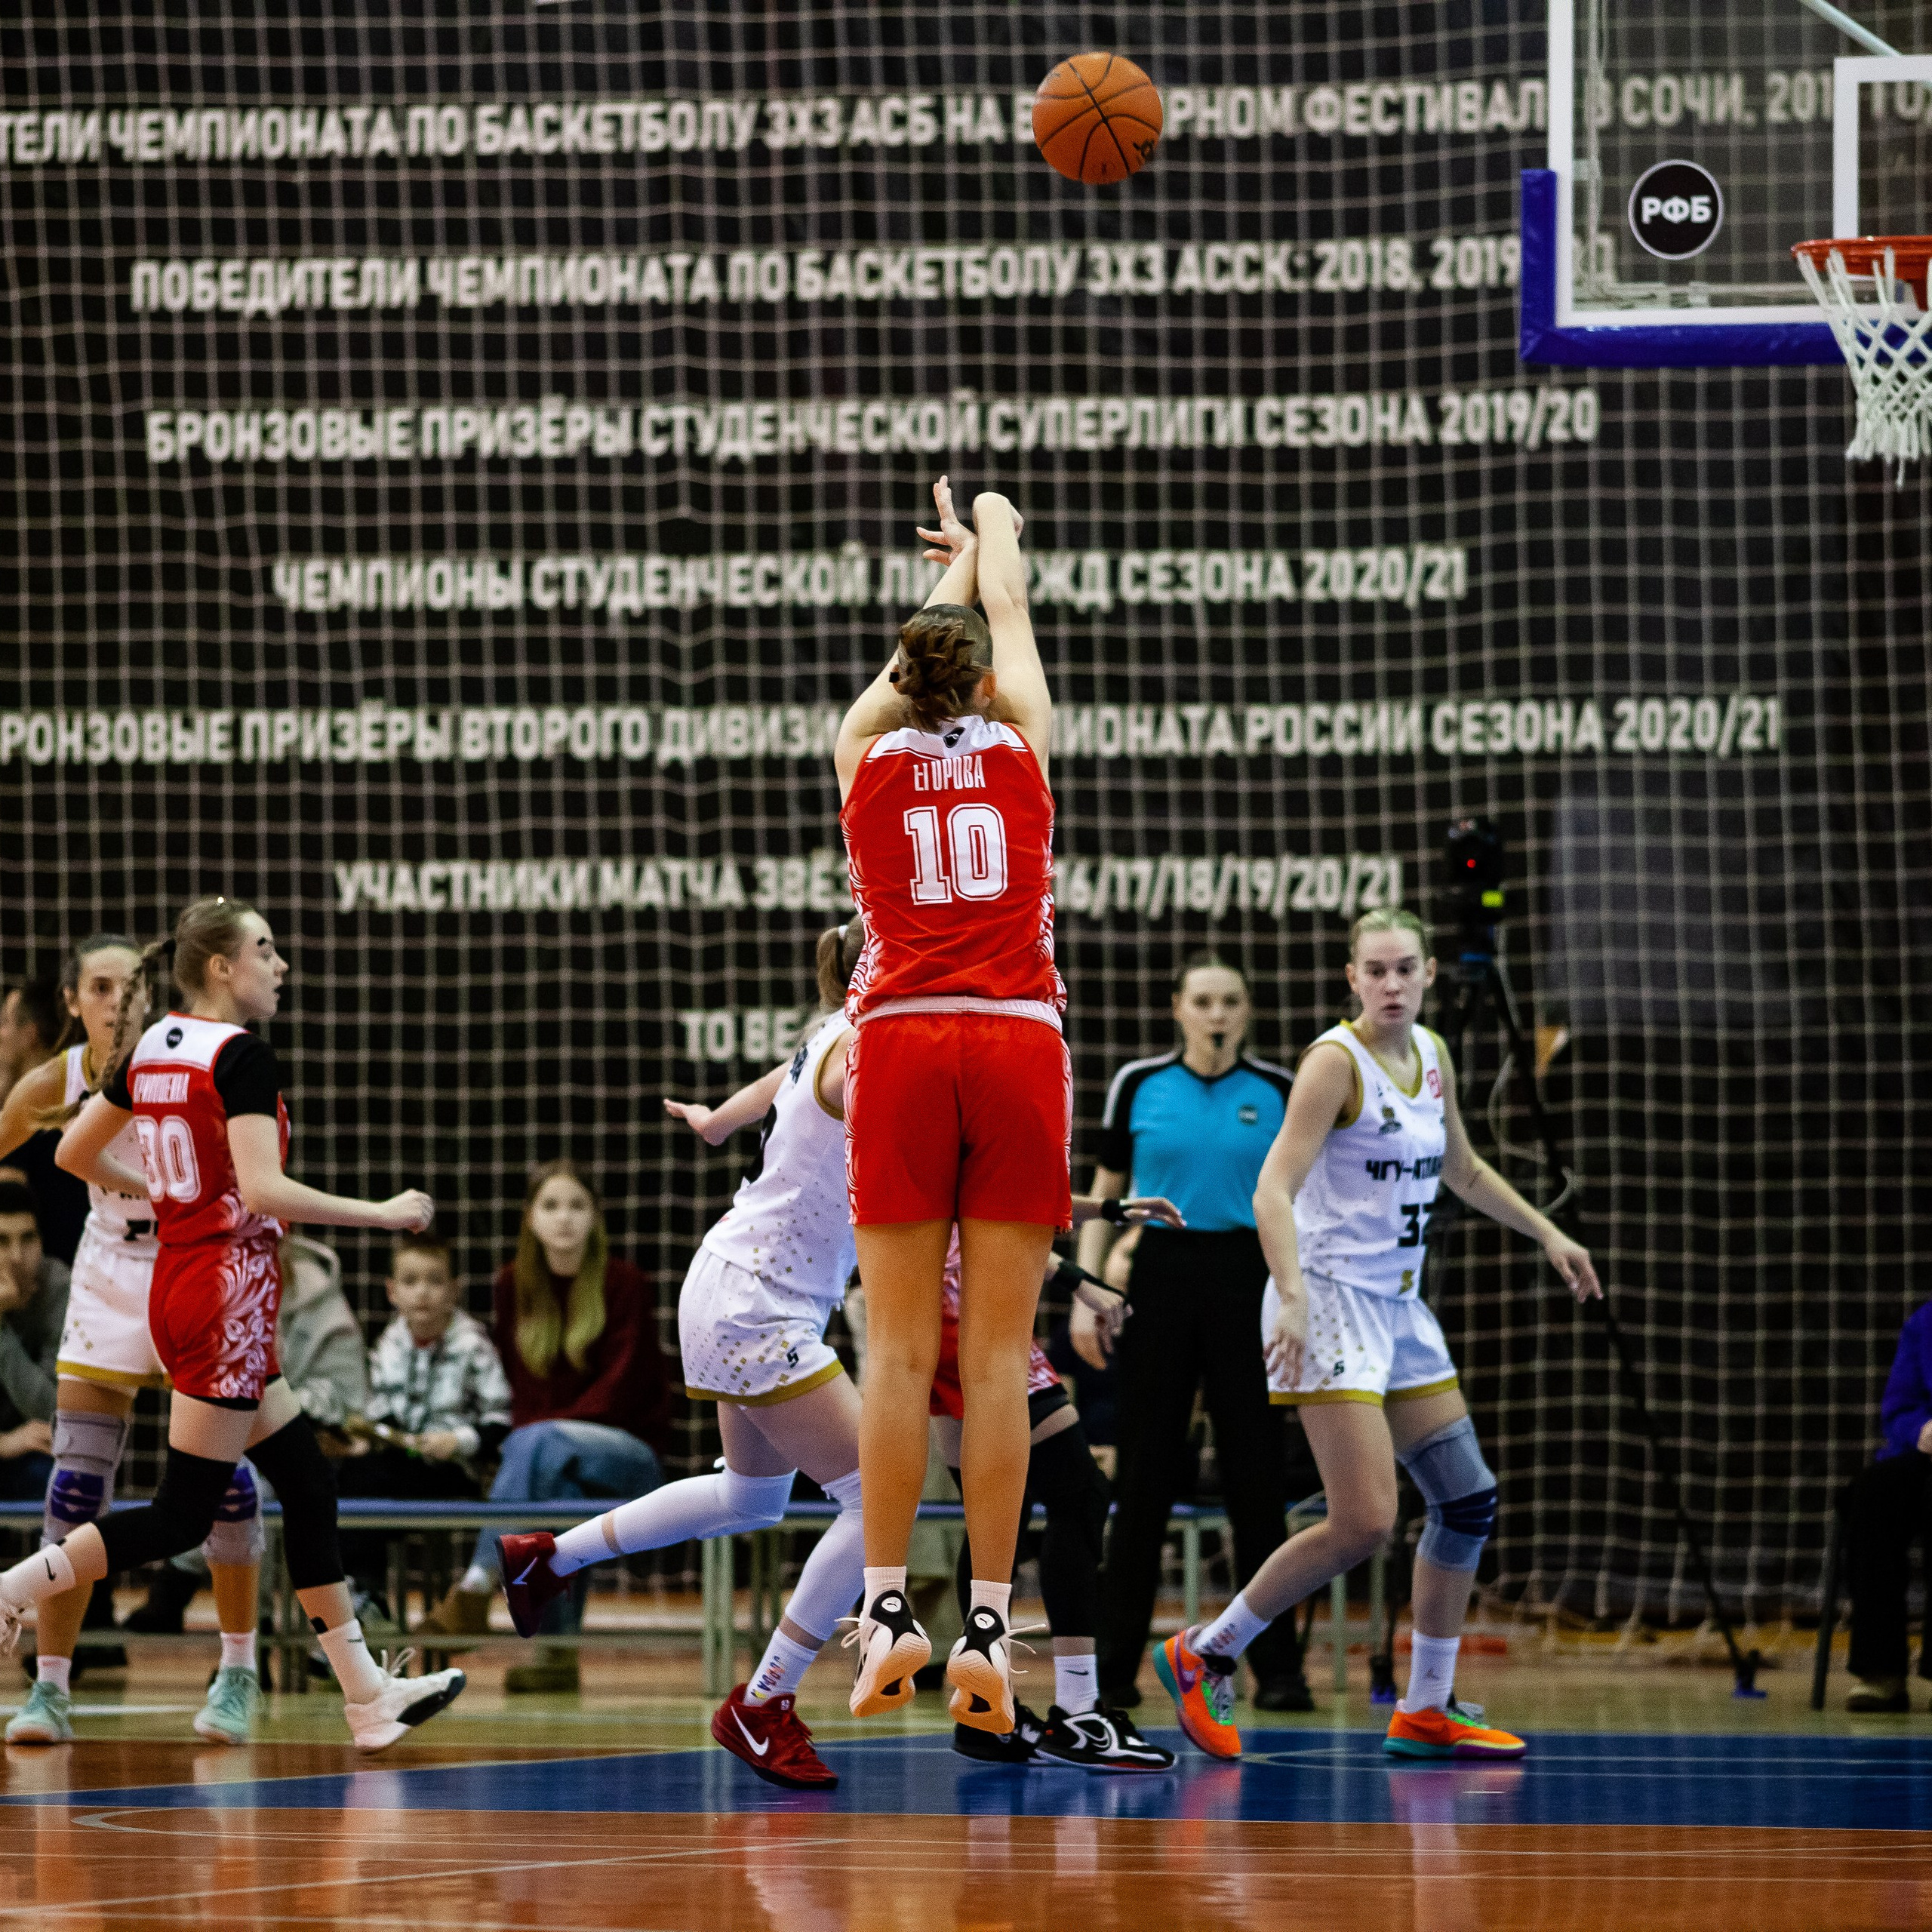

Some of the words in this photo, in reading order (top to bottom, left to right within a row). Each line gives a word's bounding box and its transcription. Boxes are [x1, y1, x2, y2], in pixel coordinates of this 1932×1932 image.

[108, 106, 398, 162] ЧЕМПИОНАТА
[407, 105, 468, 157] ПО
[475, 101, 758, 155] БАСКЕТБОЛУ
[848, 95, 937, 149] АСБ
[942, 95, 1008, 146] НА
[1303, 78, 1547, 139] ФЕСТИВАЛ
[1766, 69, 1835, 124] 201
[1640, 195, 1713, 225] РФБ
[130, 257, 419, 321] ПОБЕДИТЕЛИ
[426, 253, 721, 309] ЧЕМПИОНАТА
[728, 251, 788, 303] ПО
[795, 245, 1080, 302] БАСКЕТБОЛУ
[1432, 234, 1521, 290] 2019
[147, 408, 414, 463] БРОНЗОВЫЕ
[422, 392, 635, 460] ПРИЗЁРЫ
[640, 386, 980, 466] СТУДЕНЧЕСКОЙ
[986, 394, 1245, 453] СУПЕРЛИГИ
[1254, 391, 1432, 449] СЕЗОНА
[1438, 386, 1601, 451] 2019/20
[272, 557, 526, 613] ЧЕМПИОНЫ
[531, 540, 871, 617] СТУДЕНЧЕСКОЙ
[878, 555, 943, 605] ЛИ
[1118, 549, 1297, 605] СЕЗОНА
[1301, 543, 1467, 610] 2020/21
[0, 709, 233, 764] РОНЗОВЫЕ
[241, 697, 453, 764] ПРИЗЁРЫ
[460, 705, 652, 762] ВТОРОГО
[657, 704, 841, 768] ДИВИЗИ
[1051, 703, 1235, 758] ИОНАТА
[1244, 700, 1425, 756] РОССИИ
[1433, 699, 1605, 755] СЕЗОНА
[1612, 694, 1782, 758] 2020/21
[334, 857, 589, 913] УЧАСТНИКИ
[601, 857, 746, 911] МАТЧА
[753, 848, 854, 910] ЗВЁ
[903, 802, 1008, 905] 10
